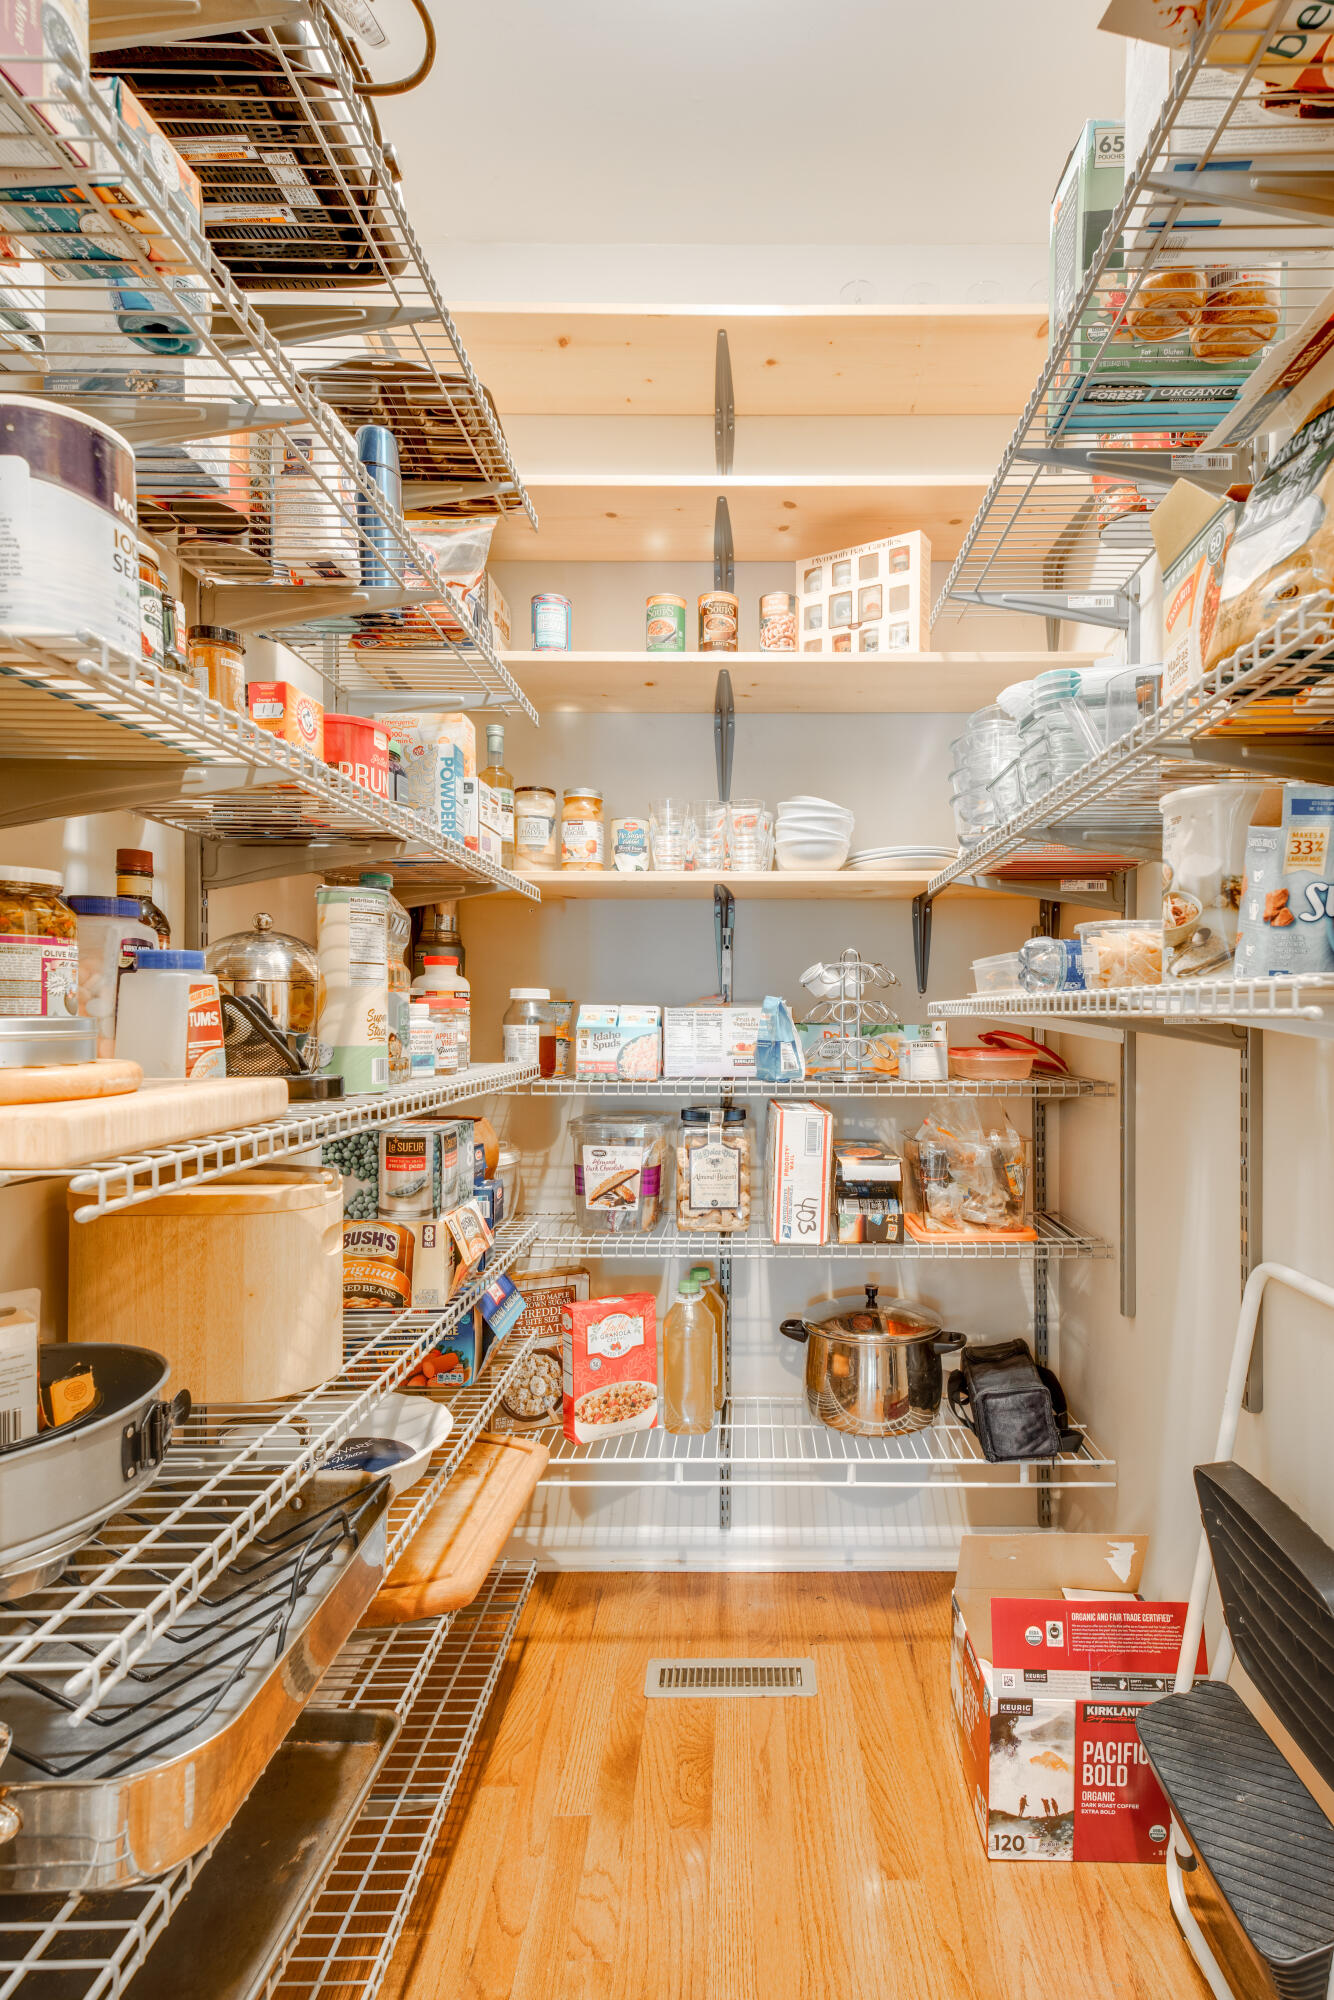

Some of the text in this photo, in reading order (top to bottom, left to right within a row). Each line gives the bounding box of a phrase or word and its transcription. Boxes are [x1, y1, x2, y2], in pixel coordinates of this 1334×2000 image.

[1266, 0, 1334, 59] be
[1099, 135, 1125, 153] 65
[1088, 391, 1145, 400] FOREST
[1160, 387, 1234, 398] ORGANIC
[338, 760, 389, 795] PRUN
[1290, 840, 1324, 855] 33%
[43, 949, 67, 958] OLIVE
[188, 1011, 219, 1027] TUMS
[593, 1031, 621, 1042] Idaho
[592, 1039, 621, 1051] Spuds
[397, 1141, 424, 1152] SUEUR
[467, 1141, 474, 1166] 8
[793, 1197, 819, 1235] 403
[343, 1230, 397, 1252] BUSH'S
[424, 1226, 435, 1241] 8
[343, 1262, 397, 1281] riginal
[343, 1283, 397, 1299] KED BEANS
[523, 1291, 570, 1303] OSTED MAPLE
[526, 1297, 571, 1309] ROWN SUGAR
[525, 1315, 560, 1326] BITE SIZE
[1071, 1612, 1096, 1621] ORGANIC
[1097, 1612, 1109, 1621] AND
[1109, 1613, 1122, 1621] FAIR
[1123, 1613, 1141, 1622] TRADE
[1082, 1764, 1128, 1787] BOLD
[1081, 1791, 1115, 1802] ORGANIC
[994, 1834, 1025, 1851] 120
